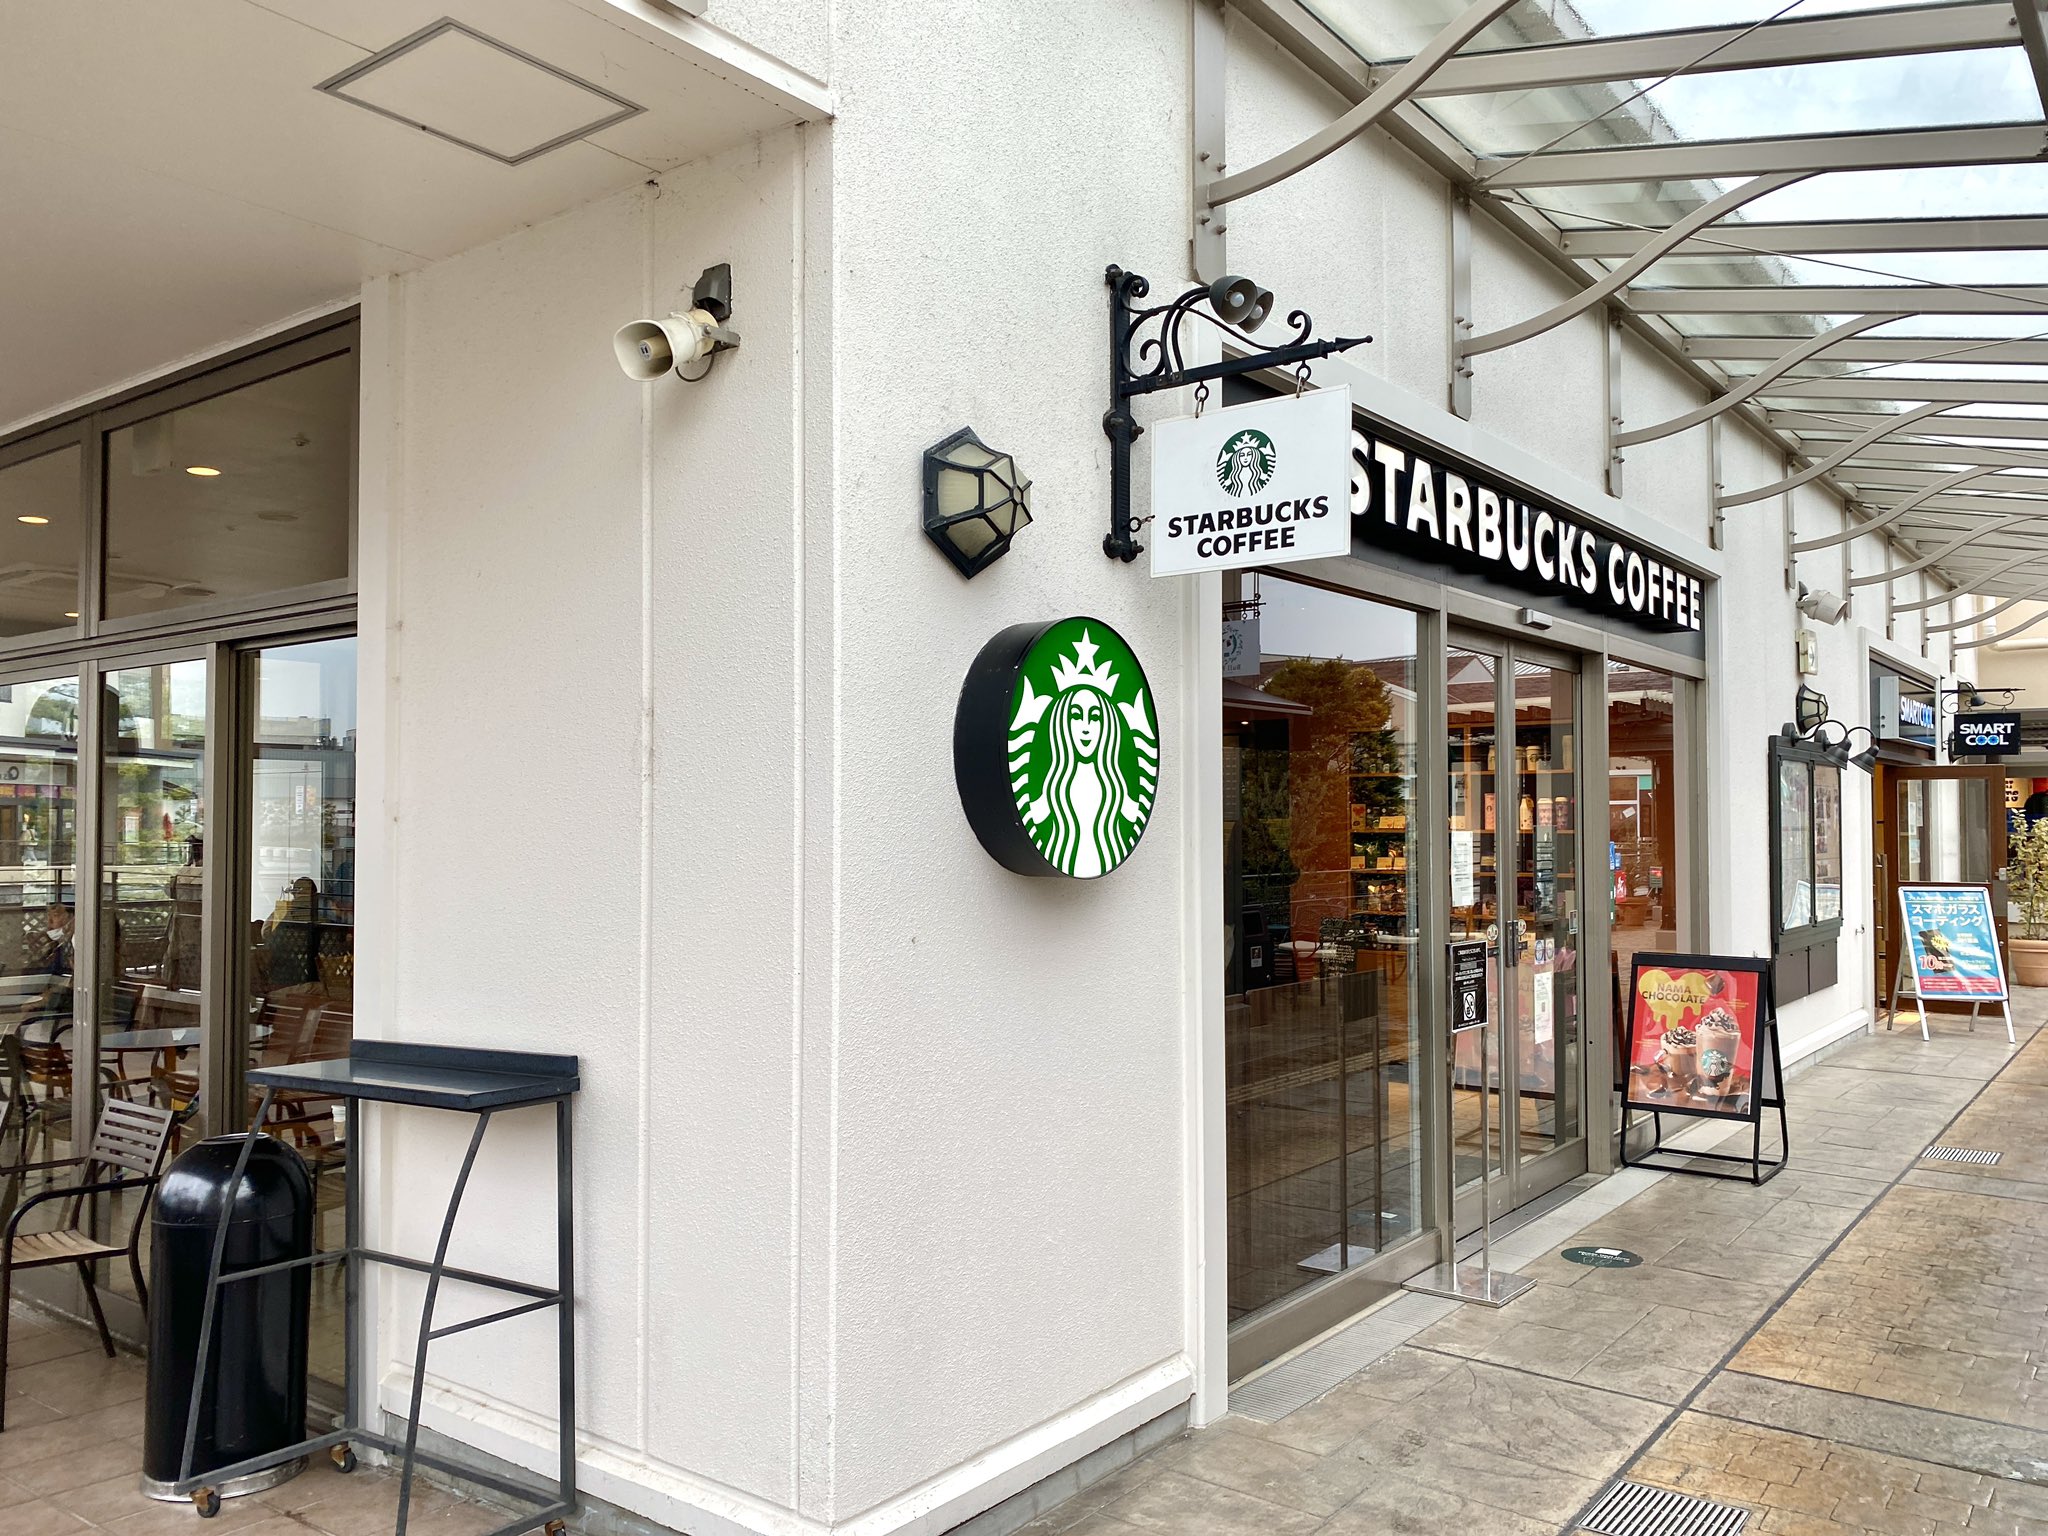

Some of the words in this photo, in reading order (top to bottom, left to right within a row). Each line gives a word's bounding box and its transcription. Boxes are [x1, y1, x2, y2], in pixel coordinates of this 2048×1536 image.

[1167, 495, 1329, 538] STARBUCKS
[1351, 430, 1597, 594] STARBUCKS
[1608, 543, 1701, 631] COFFEE
[1197, 526, 1296, 558] COFFEE
[1959, 723, 2015, 734] SMART
[1965, 735, 2009, 745] COOL
[1912, 904, 1980, 914] スマホガラス
[1912, 915, 1984, 926] コーティング
[1657, 984, 1691, 993] NAMA
[1642, 991, 1705, 1004] CHOCOLATE
